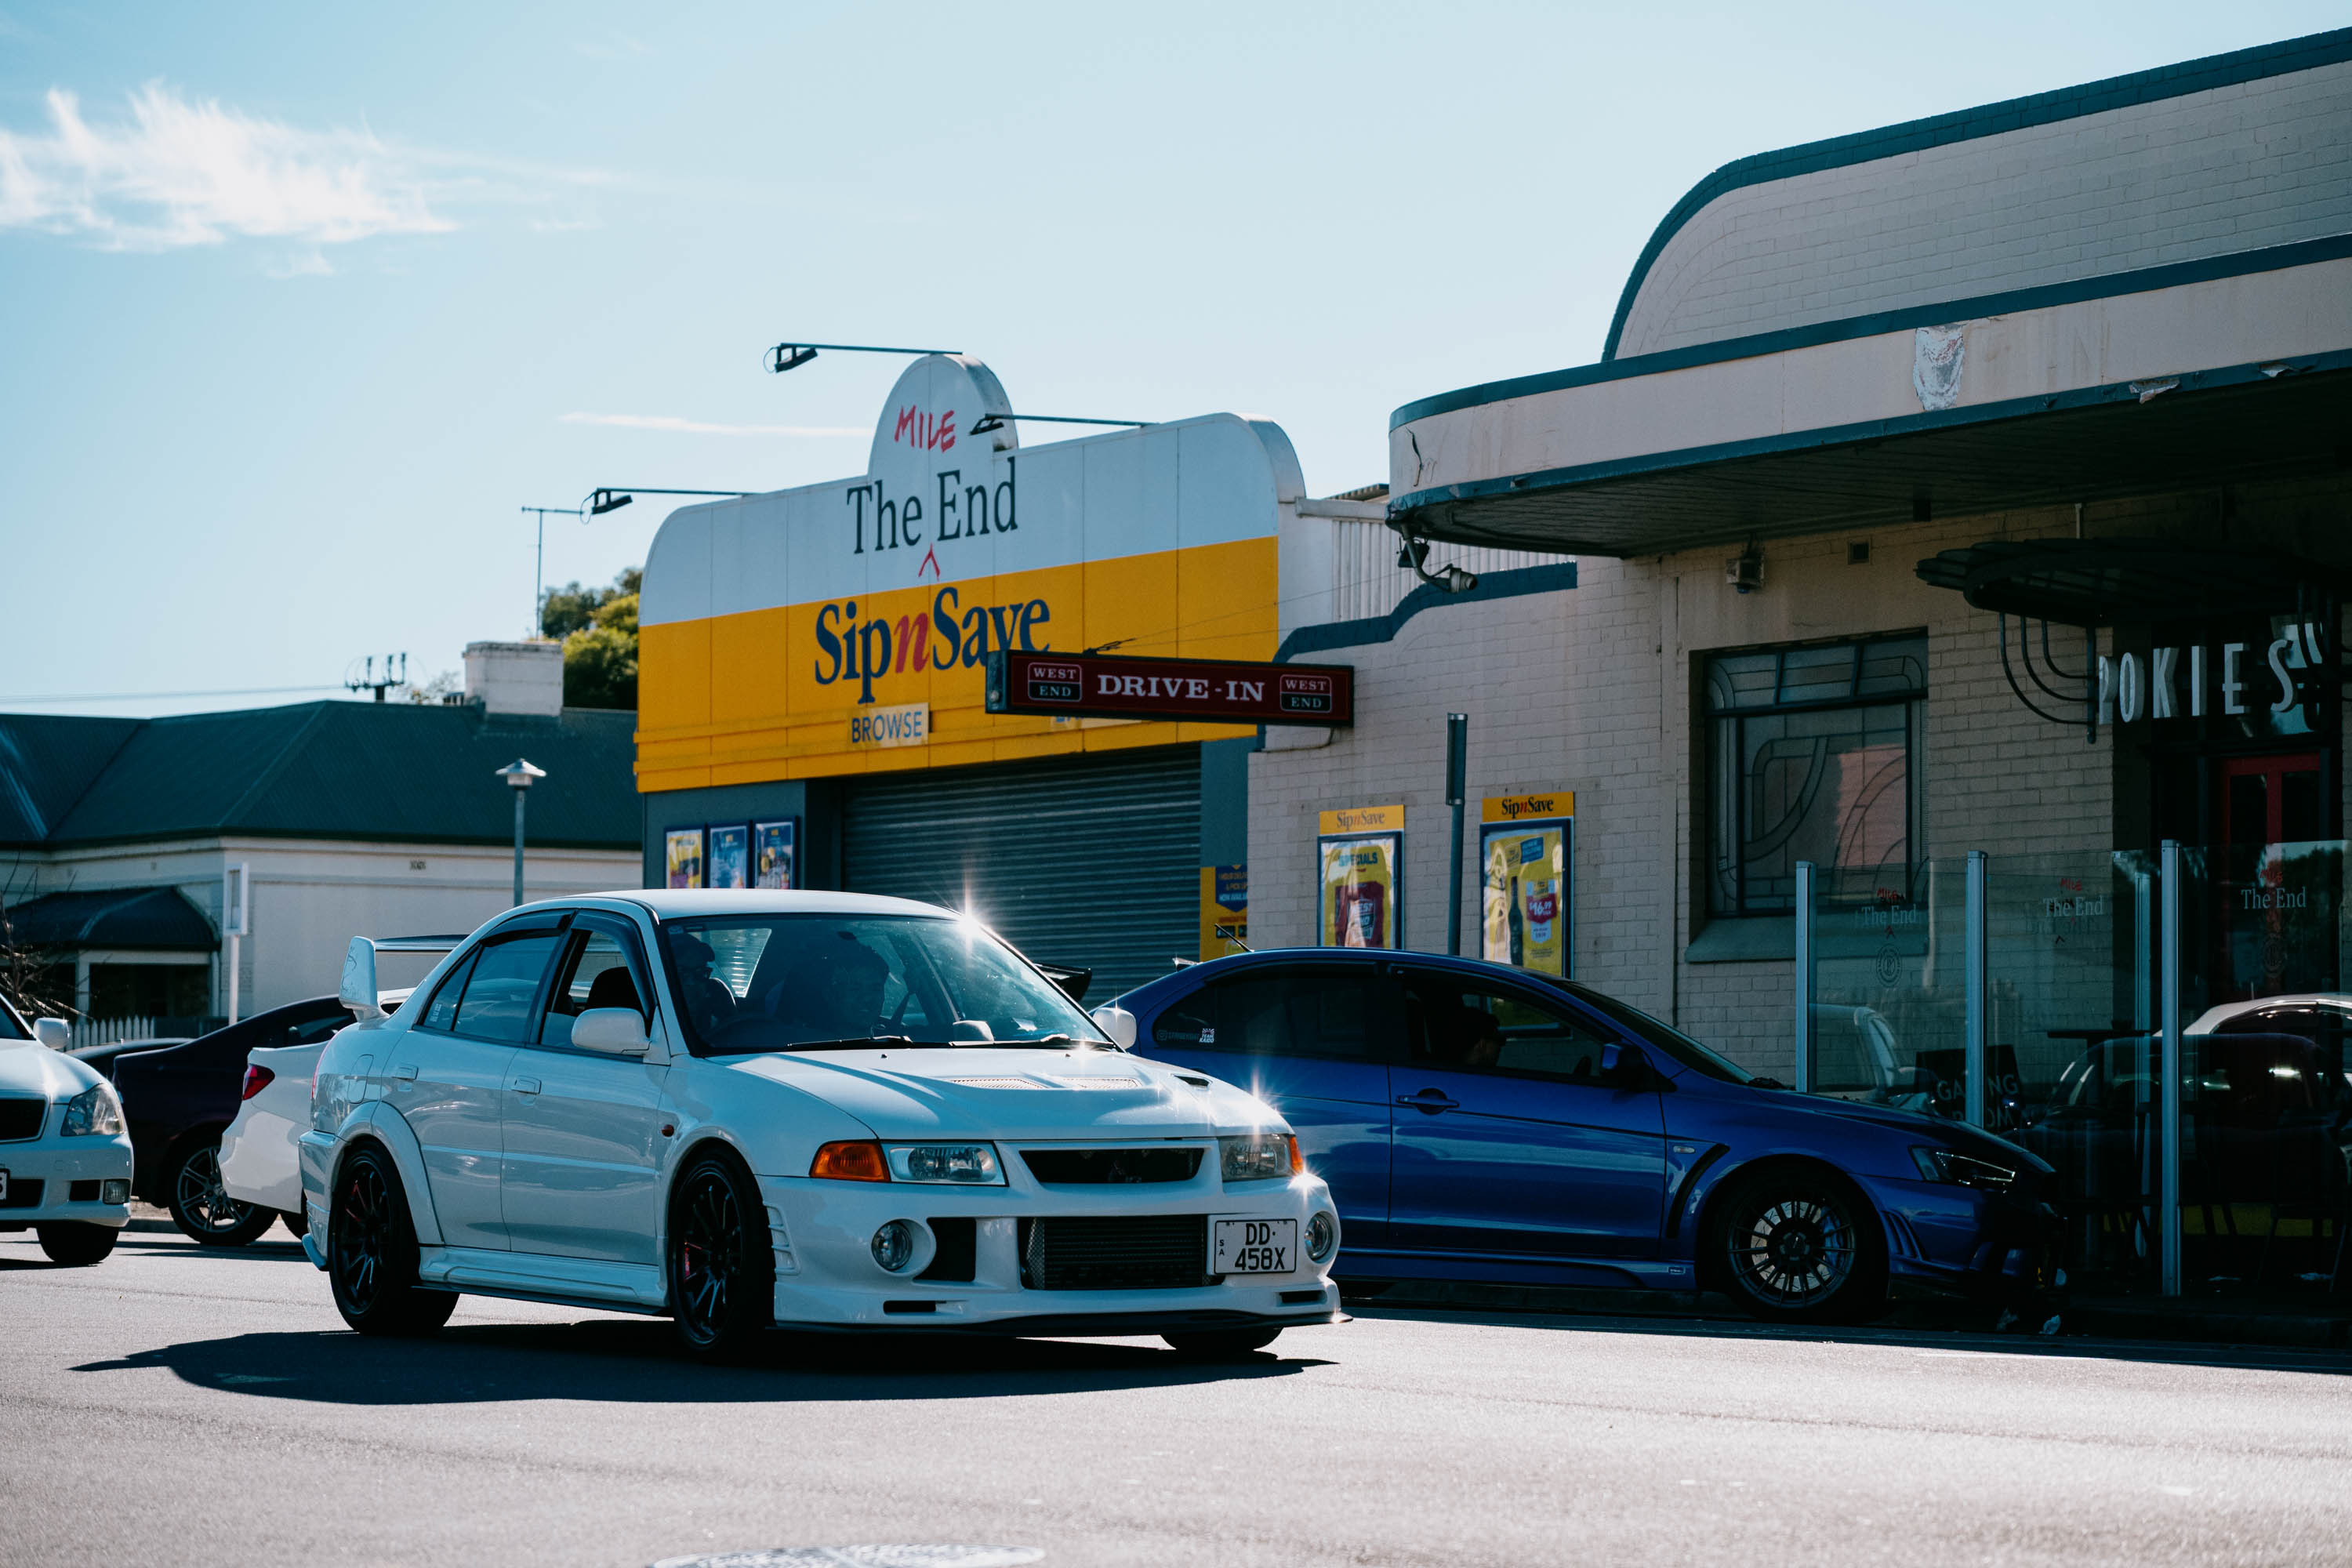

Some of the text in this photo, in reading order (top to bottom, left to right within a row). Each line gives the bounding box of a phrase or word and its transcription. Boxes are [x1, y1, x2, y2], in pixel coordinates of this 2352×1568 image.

[895, 405, 956, 452] MILE
[847, 456, 1018, 554] The End
[1033, 667, 1077, 680] WEST
[1284, 679, 1327, 691] WEST
[2098, 639, 2296, 725] POKIES
[1039, 685, 1072, 697] END
[1292, 696, 1322, 708] END
[851, 710, 923, 743] BROWSE
[2042, 894, 2103, 916] The End
[2241, 886, 2307, 909] The End
[1861, 903, 1917, 924] The End
[1938, 1073, 2020, 1101] GANG
[1235, 1247, 1286, 1270] 458X
